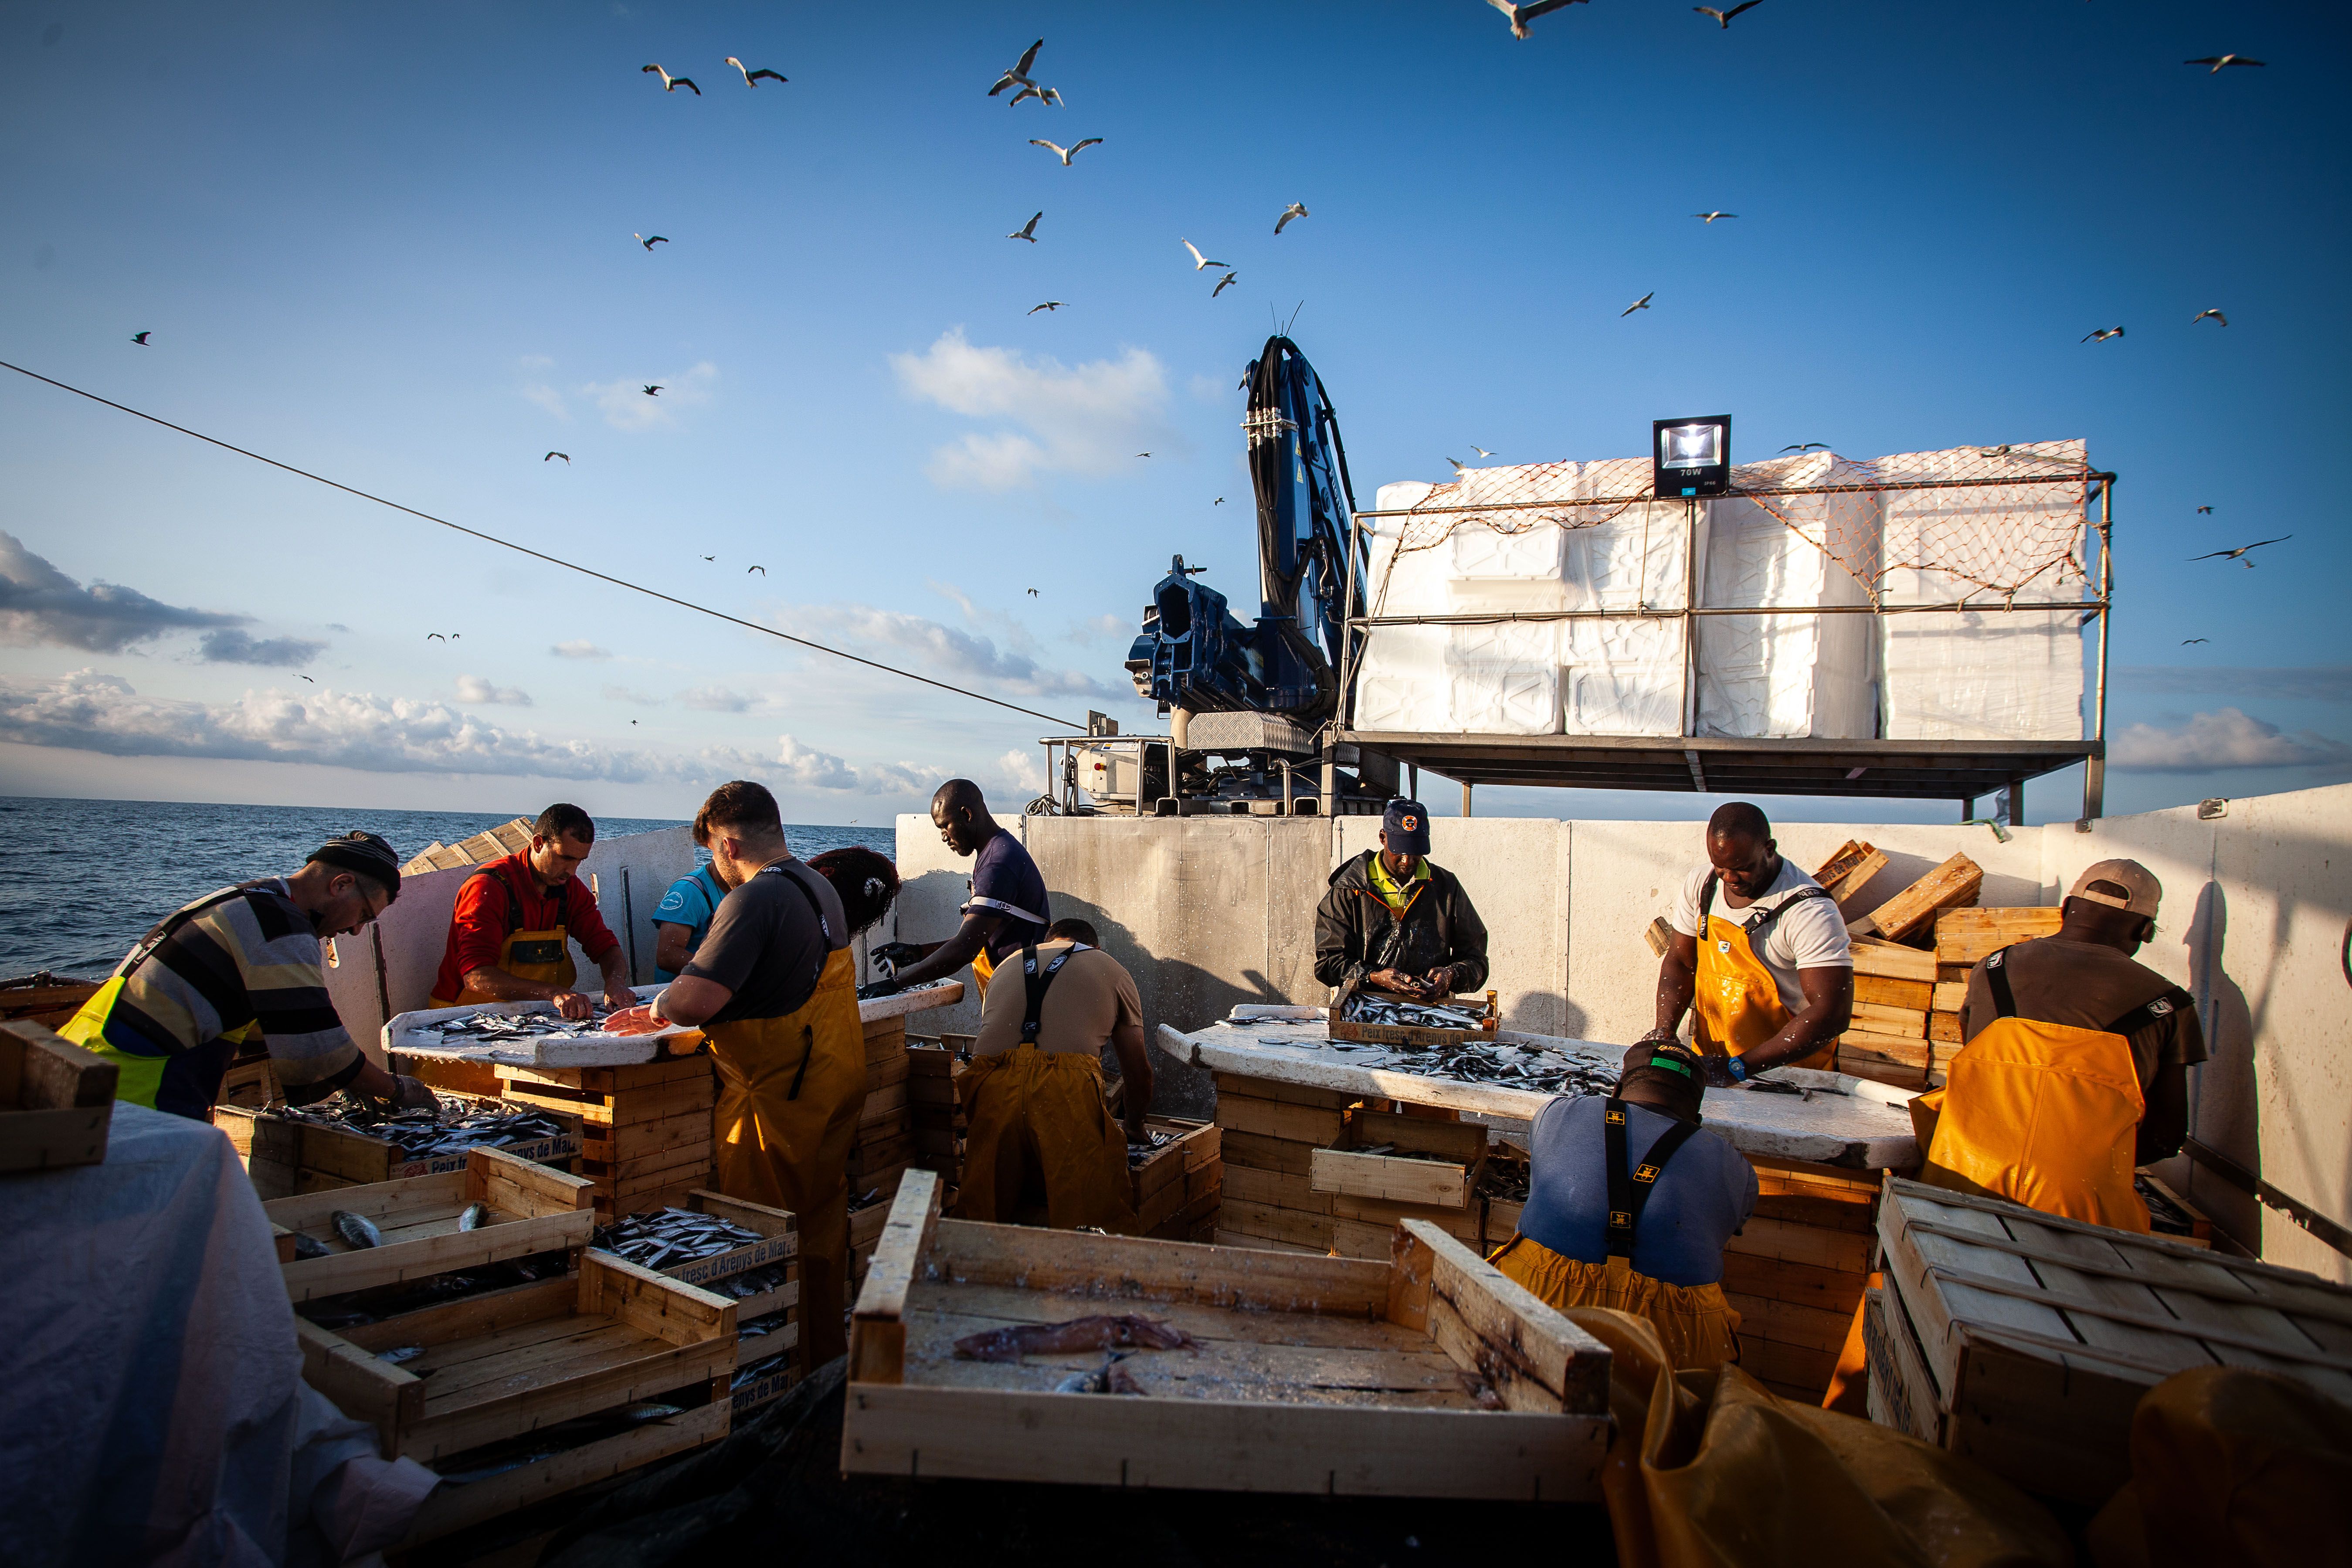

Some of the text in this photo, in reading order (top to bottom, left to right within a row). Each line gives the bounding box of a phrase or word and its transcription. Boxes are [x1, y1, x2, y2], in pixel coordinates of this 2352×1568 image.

[1680, 468, 1702, 476] 70W
[1834, 864, 1846, 874] de
[1843, 855, 1860, 869] Mar
[1362, 1025, 1381, 1039] Peix
[1382, 1027, 1405, 1040] fresc
[1408, 1028, 1447, 1045] d'Arenys
[1449, 1032, 1461, 1045] de
[501, 1146, 535, 1160] renys
[538, 1141, 550, 1158] de
[553, 1138, 571, 1155] Mar
[432, 1158, 455, 1174] Peix
[682, 1264, 709, 1283] fresc
[711, 1250, 753, 1276] d'Arenys
[755, 1245, 766, 1263] de
[768, 1240, 786, 1259] Mar
[733, 1388, 755, 1408] enys
[758, 1381, 769, 1399] de
[771, 1375, 788, 1394] Mar
